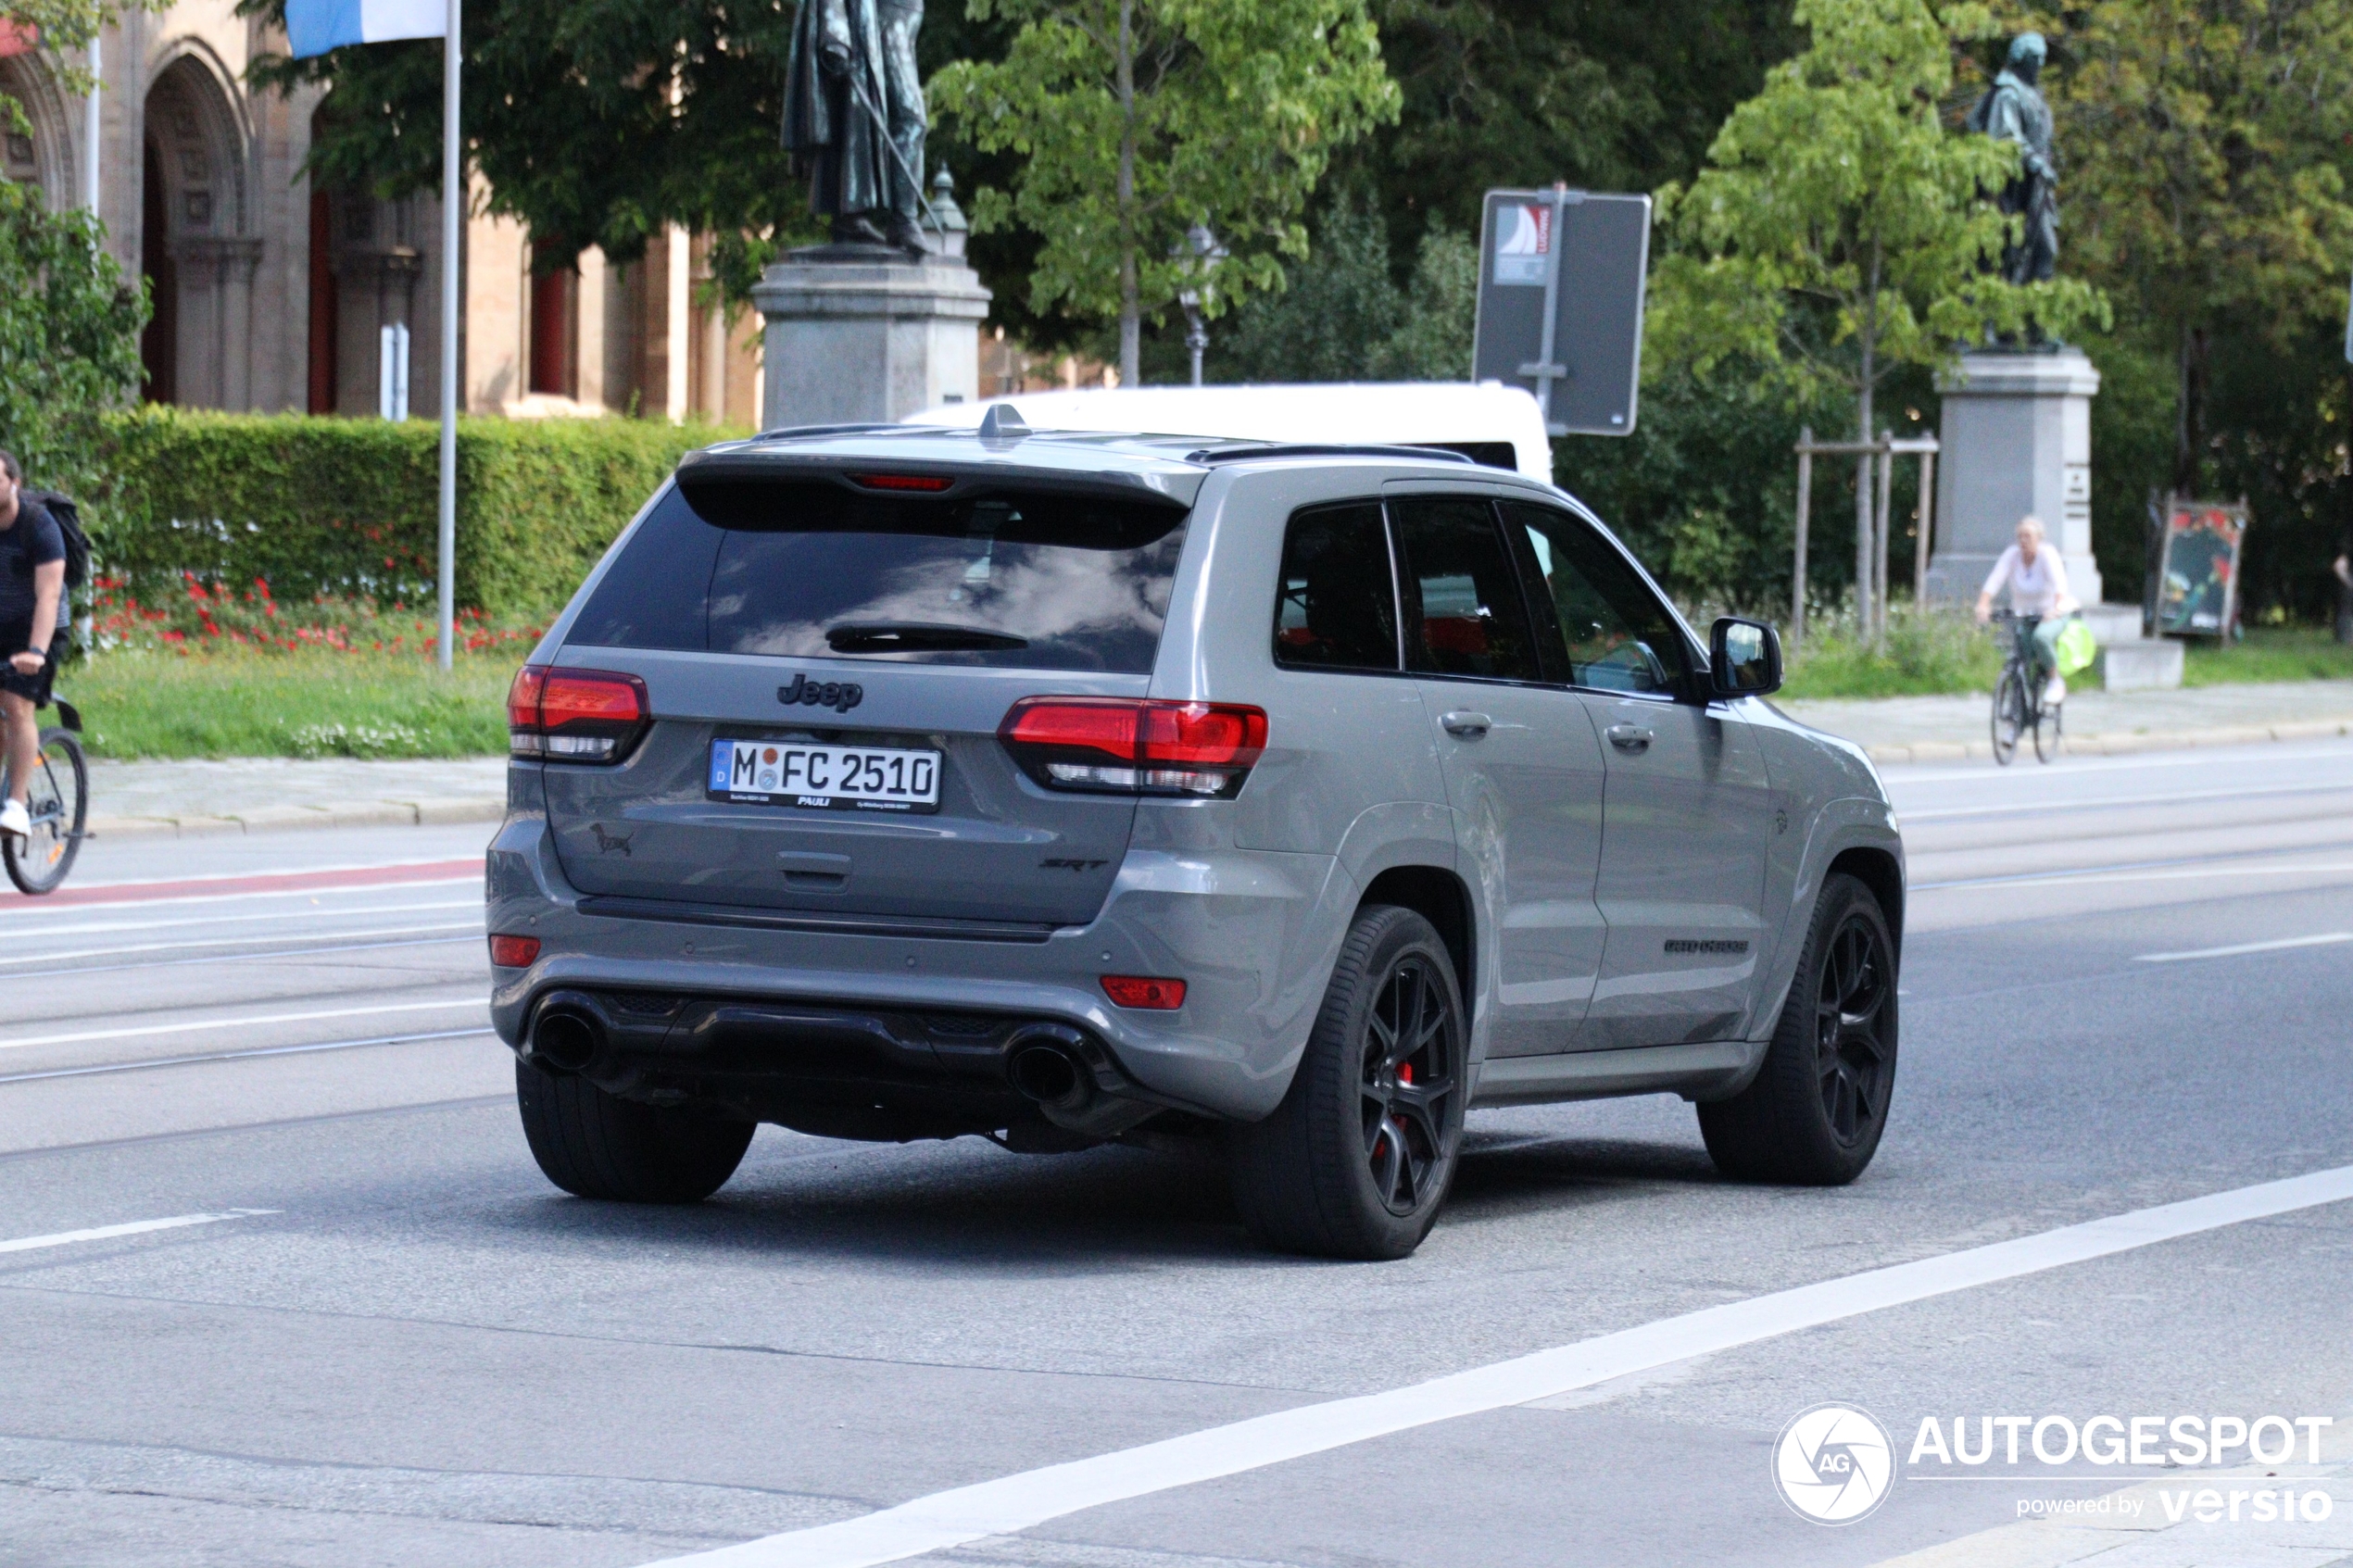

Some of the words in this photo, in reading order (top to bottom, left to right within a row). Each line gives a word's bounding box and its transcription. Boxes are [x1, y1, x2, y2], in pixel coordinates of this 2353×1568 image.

[777, 674, 863, 714] Jeep
[716, 771, 725, 783] D
[733, 748, 757, 785] M
[783, 751, 829, 793] FC
[839, 754, 933, 796] 2510
[798, 796, 830, 807] PAULI
